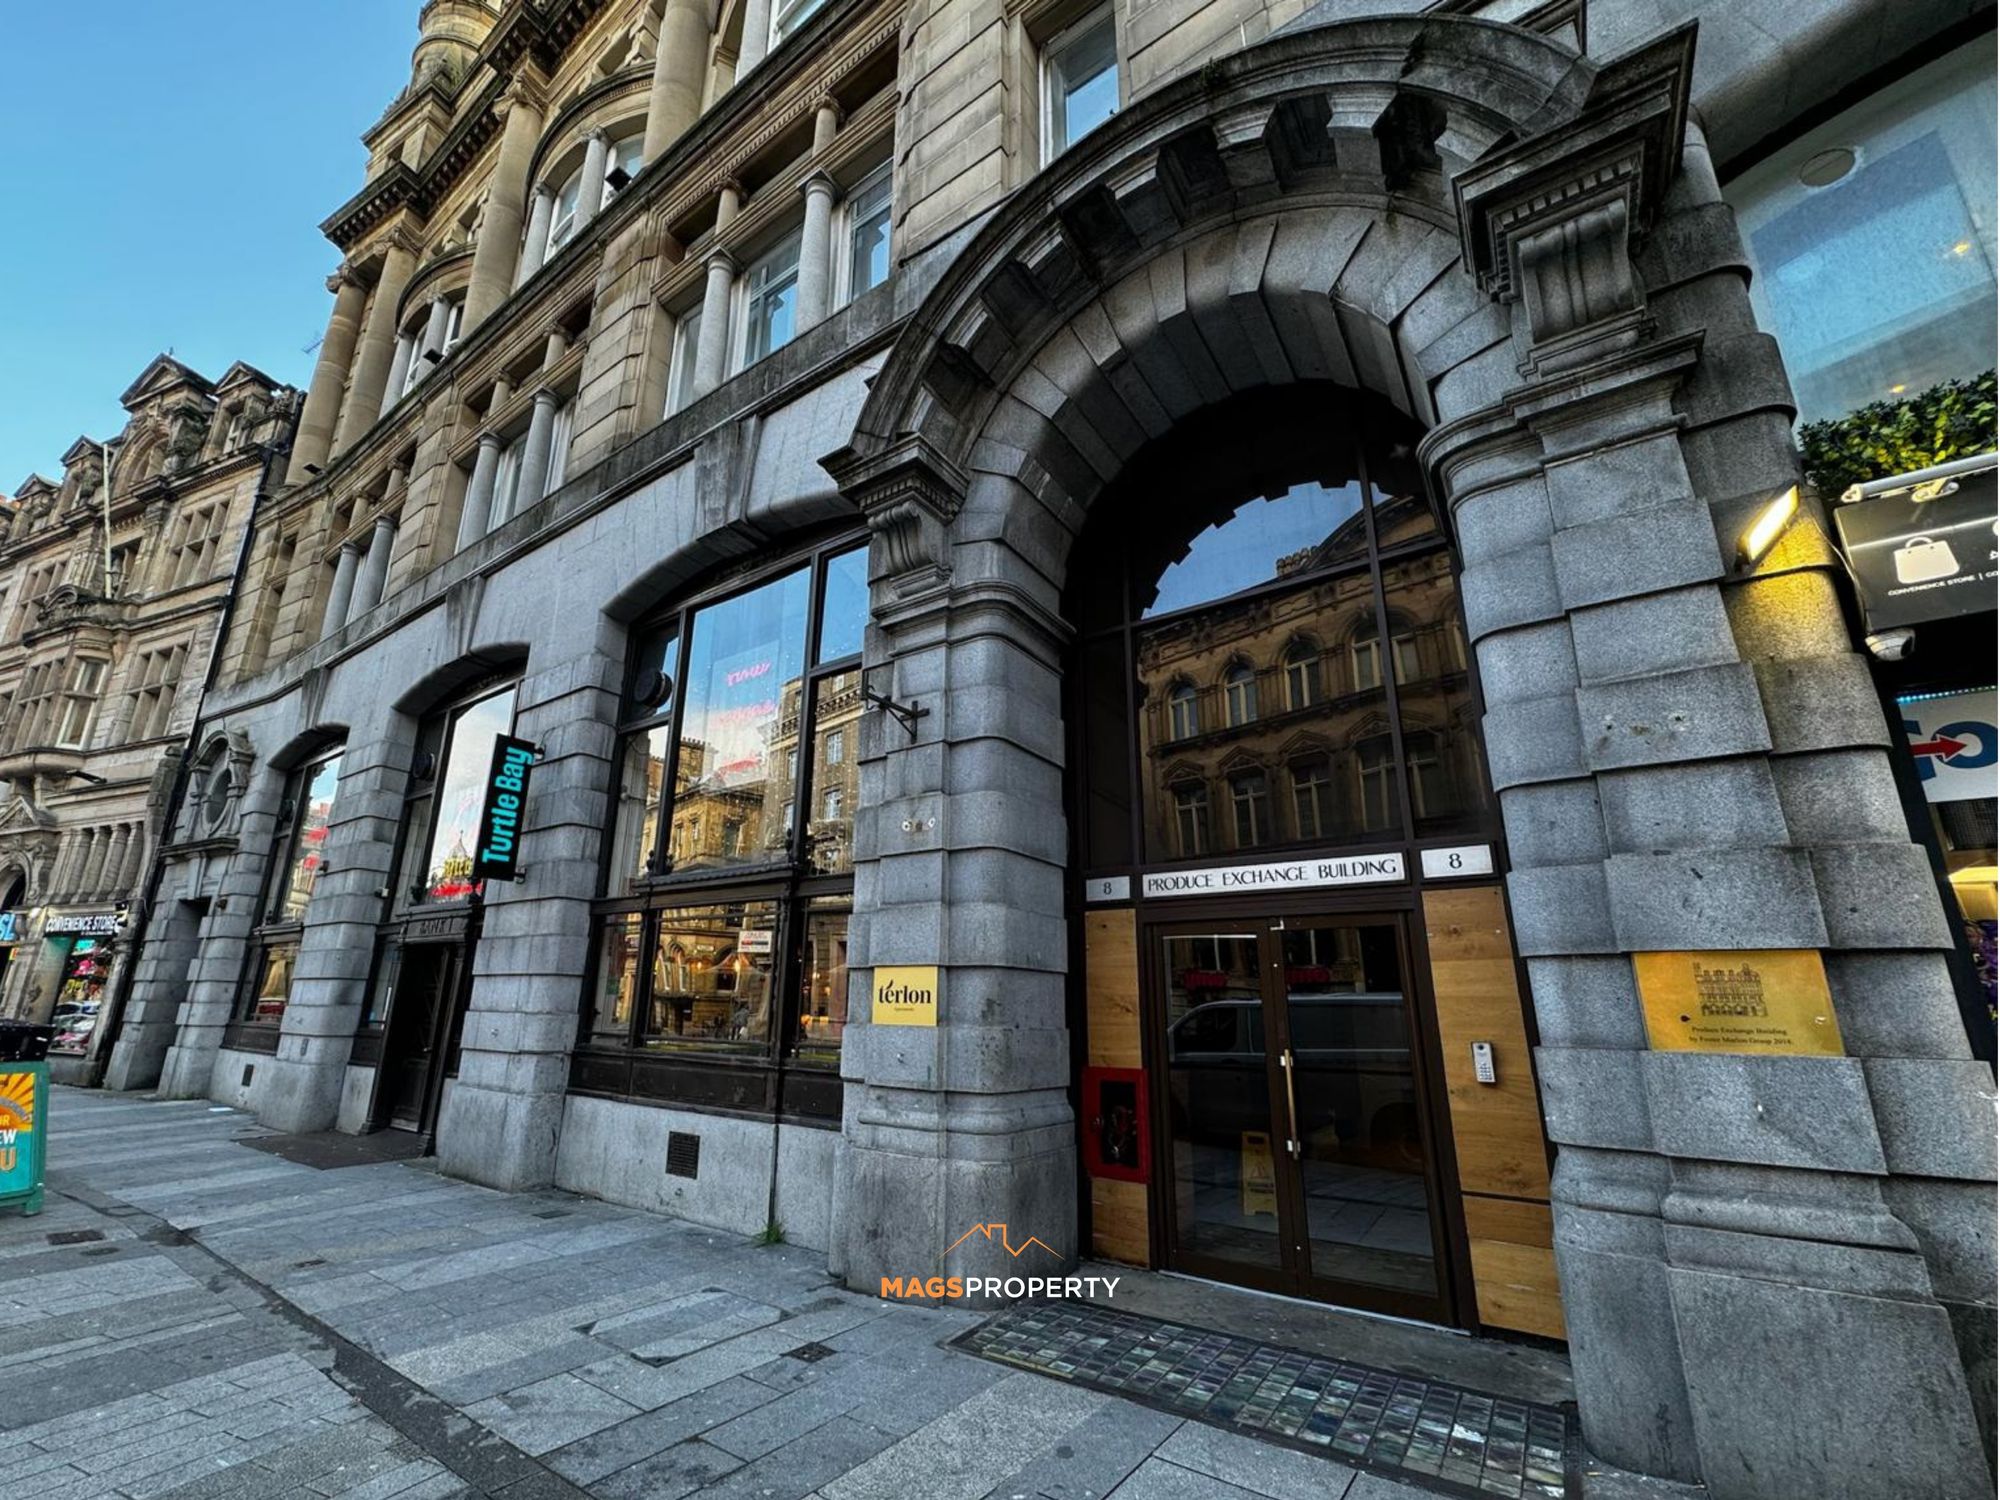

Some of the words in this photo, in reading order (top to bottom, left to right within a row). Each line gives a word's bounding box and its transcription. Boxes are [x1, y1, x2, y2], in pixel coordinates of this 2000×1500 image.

[1888, 580, 1946, 596] CONVENIENCE
[1947, 575, 1976, 586] STORE
[495, 746, 535, 792] Bay
[481, 793, 520, 863] Turtle
[1449, 853, 1462, 869] 8
[1148, 873, 1216, 892] PRODUCE
[1222, 865, 1309, 887] EXCHANGE
[1318, 858, 1397, 879] BUILDING
[1103, 881, 1112, 896] 8
[92, 914, 118, 930] STORE
[878, 978, 931, 1004] térlon
